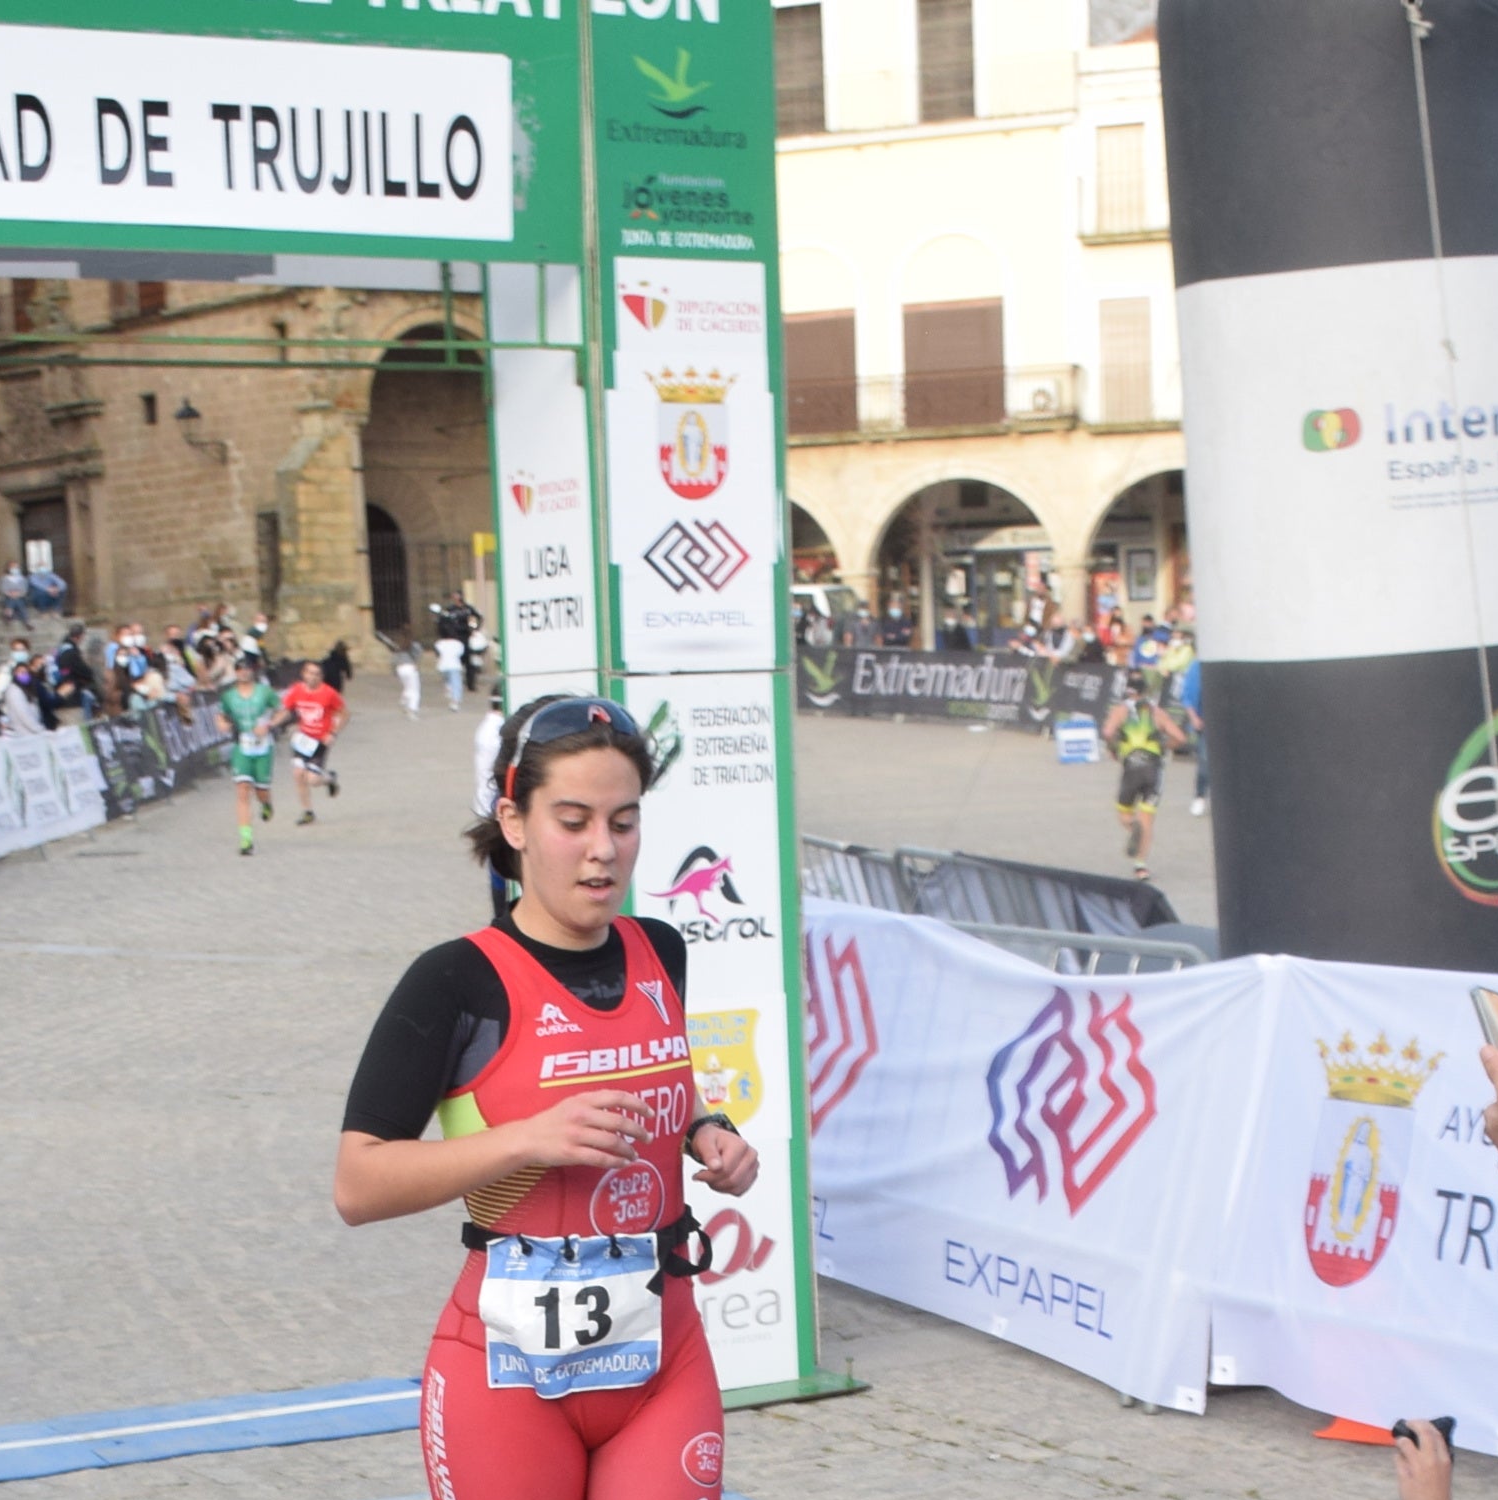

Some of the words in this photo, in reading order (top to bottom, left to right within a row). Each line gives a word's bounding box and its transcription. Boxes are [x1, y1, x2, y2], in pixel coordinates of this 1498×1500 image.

[95, 97, 175, 188] DE
[210, 102, 483, 201] TRUJILLO
[524, 545, 571, 580] LIGA
[517, 595, 583, 634] FEXTRI
[643, 611, 753, 628] EXPAPEL
[851, 654, 1028, 701] Extremadura
[691, 704, 770, 726] FEDERACIÓN
[694, 734, 769, 757] EXTREMEÑA
[693, 767, 709, 786] DE
[536, 1023, 583, 1037] austral
[540, 1036, 689, 1079] ISBILYA
[945, 1240, 1113, 1340] EXPAPEL
[534, 1285, 613, 1350] 13
[701, 1288, 782, 1330] rea
[535, 1367, 551, 1384] DE
[555, 1353, 651, 1380] EXTREMADURA
